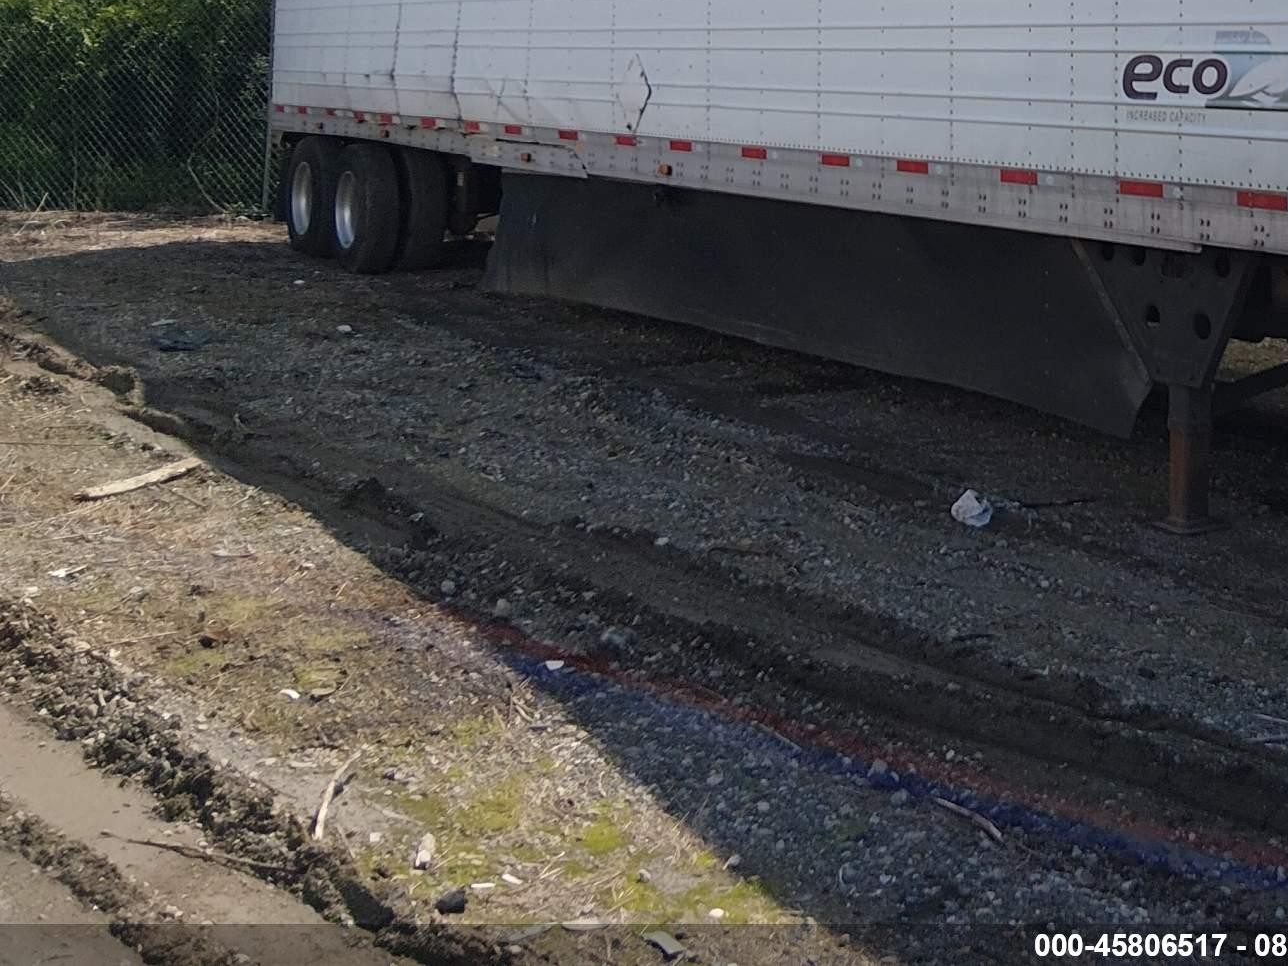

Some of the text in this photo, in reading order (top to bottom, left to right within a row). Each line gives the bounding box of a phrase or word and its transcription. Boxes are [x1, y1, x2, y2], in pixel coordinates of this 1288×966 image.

[1122, 54, 1228, 101] eco
[1126, 110, 1207, 124] INCREASED CAPACITY
